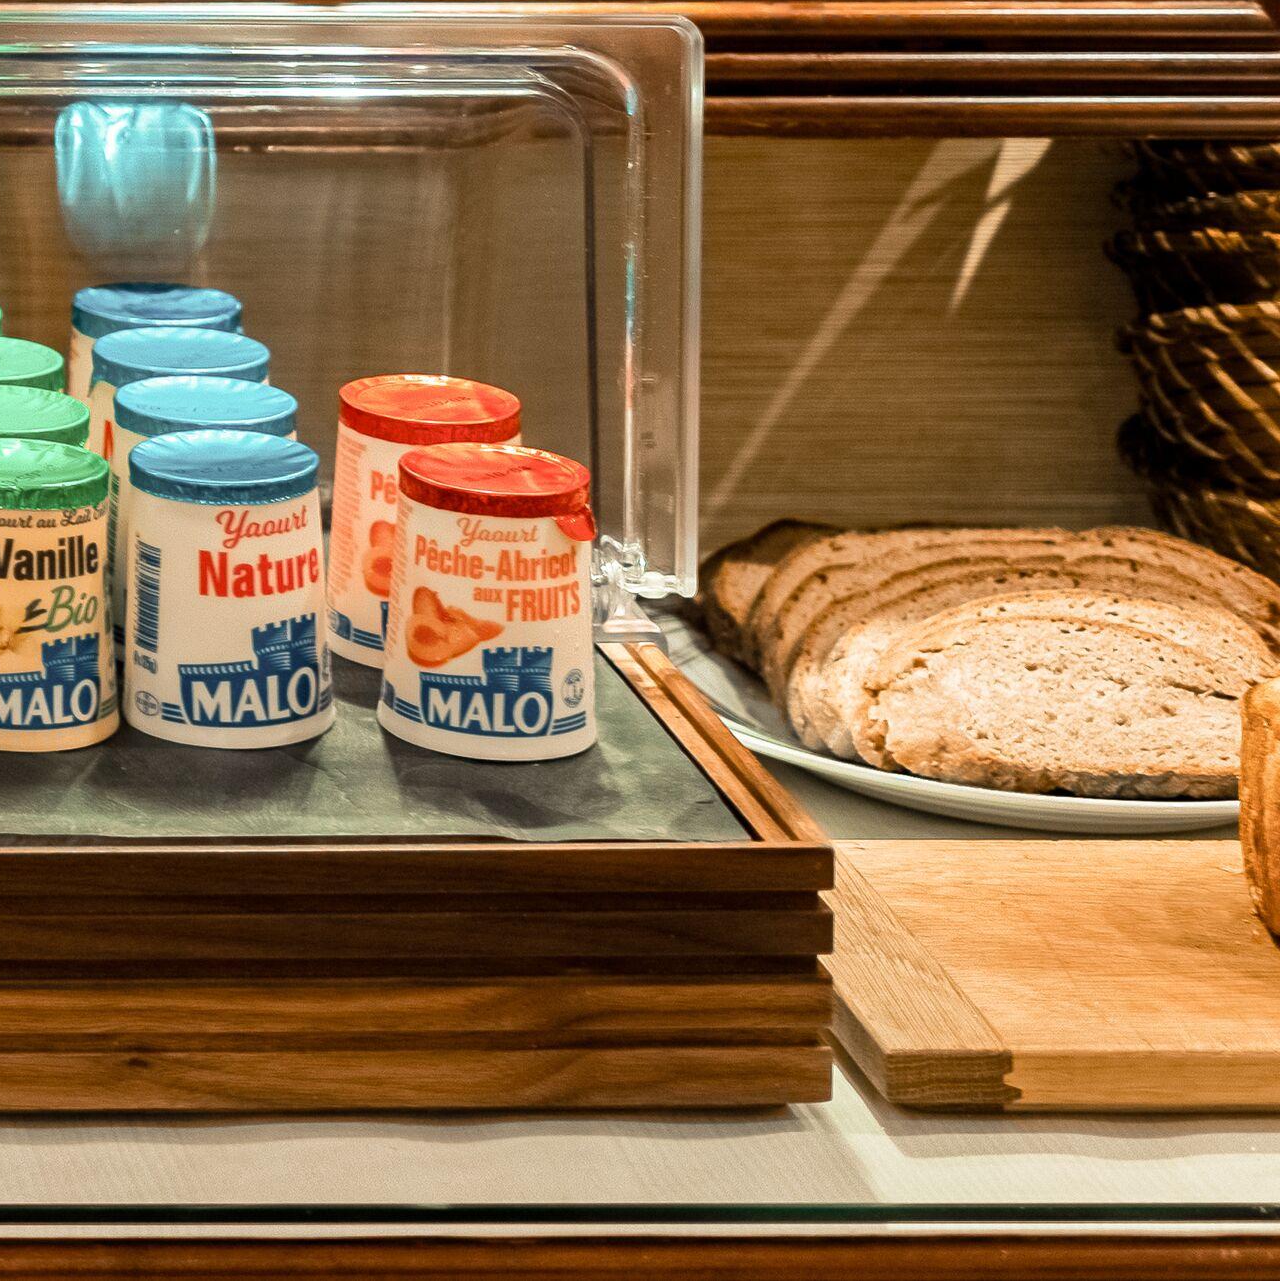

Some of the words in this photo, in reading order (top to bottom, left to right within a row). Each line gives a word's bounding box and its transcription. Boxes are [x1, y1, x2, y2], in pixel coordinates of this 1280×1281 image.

[36, 517, 57, 528] au
[215, 504, 308, 549] Yaourt
[457, 517, 540, 547] Yaourt
[198, 547, 319, 598] Nature
[414, 533, 578, 582] Pêche-Abricot
[44, 585, 98, 633] Bio
[473, 586, 503, 604] aux
[506, 580, 580, 622] FRUITS
[190, 666, 318, 723] MALO
[427, 688, 550, 736] MALO
